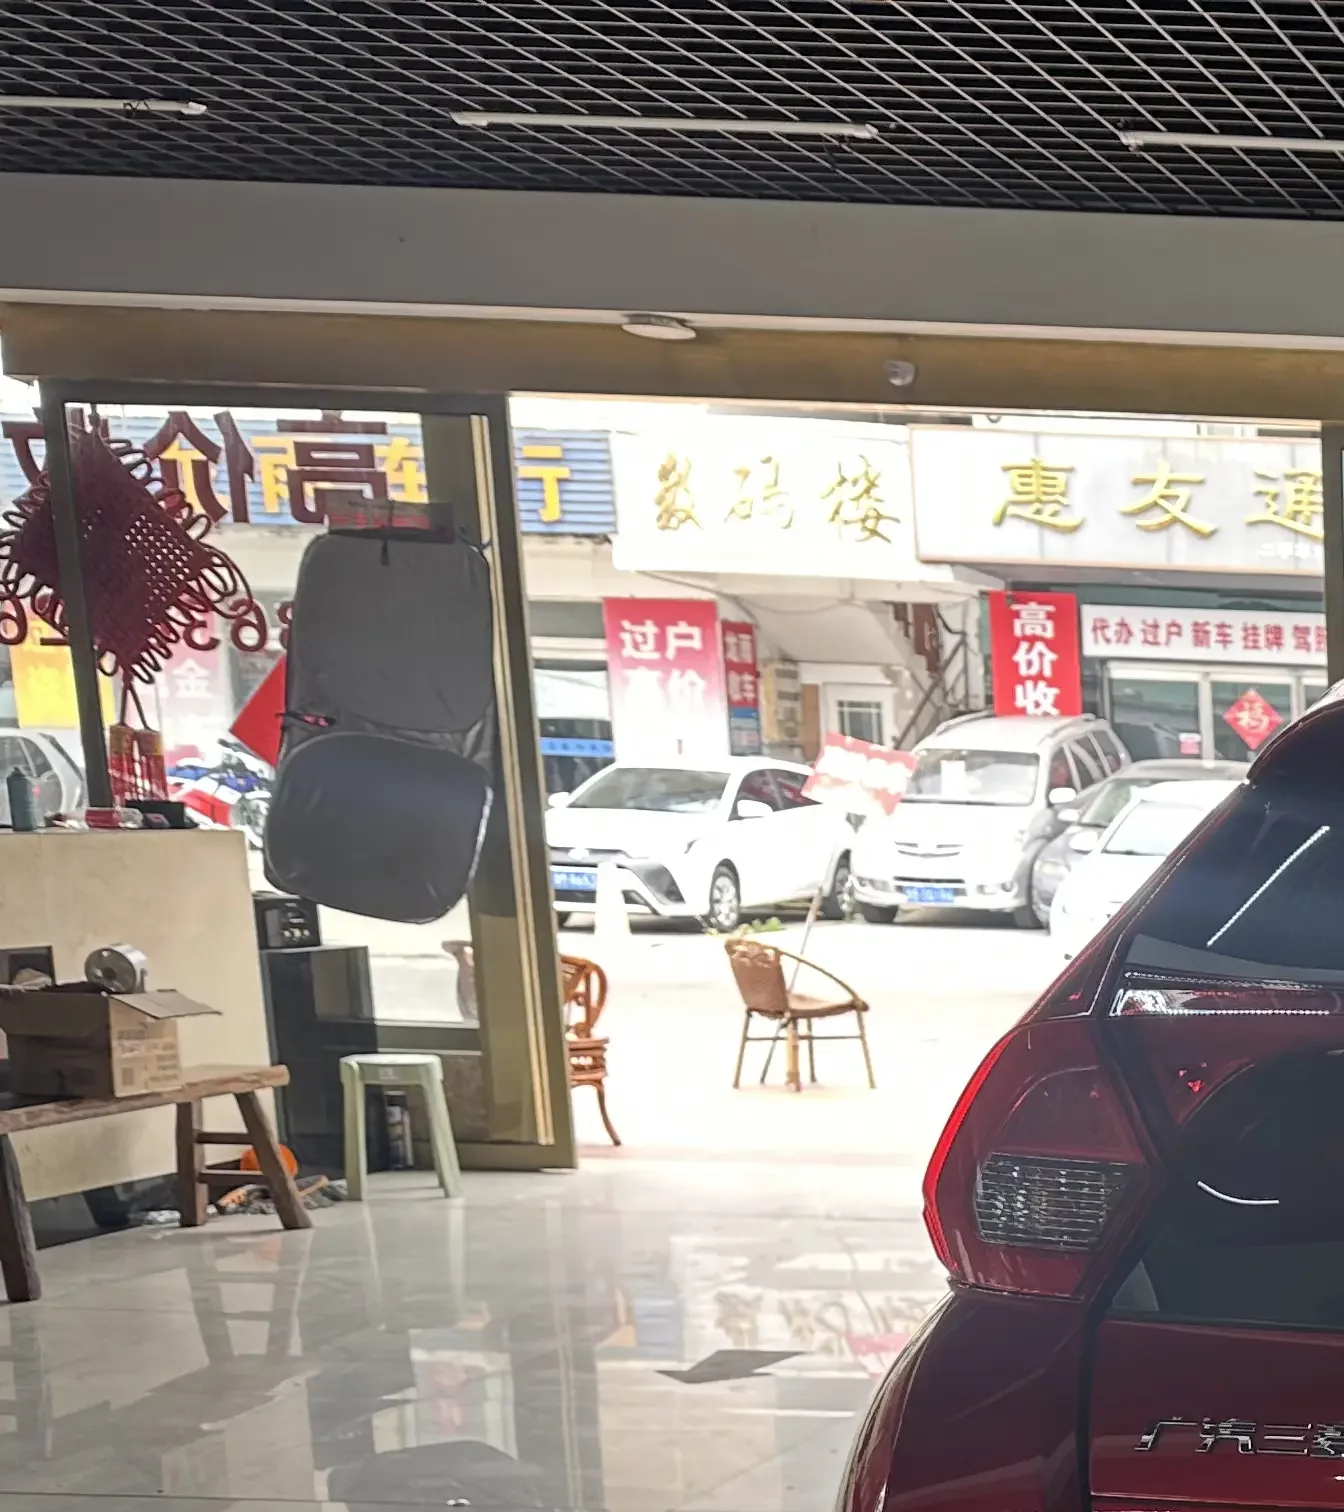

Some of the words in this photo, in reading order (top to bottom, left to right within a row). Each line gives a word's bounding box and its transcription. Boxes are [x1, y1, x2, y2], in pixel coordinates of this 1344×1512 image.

[991, 457, 1325, 541] 惠友通
[619, 619, 704, 661] 过户
[1010, 601, 1061, 716] 高价收
